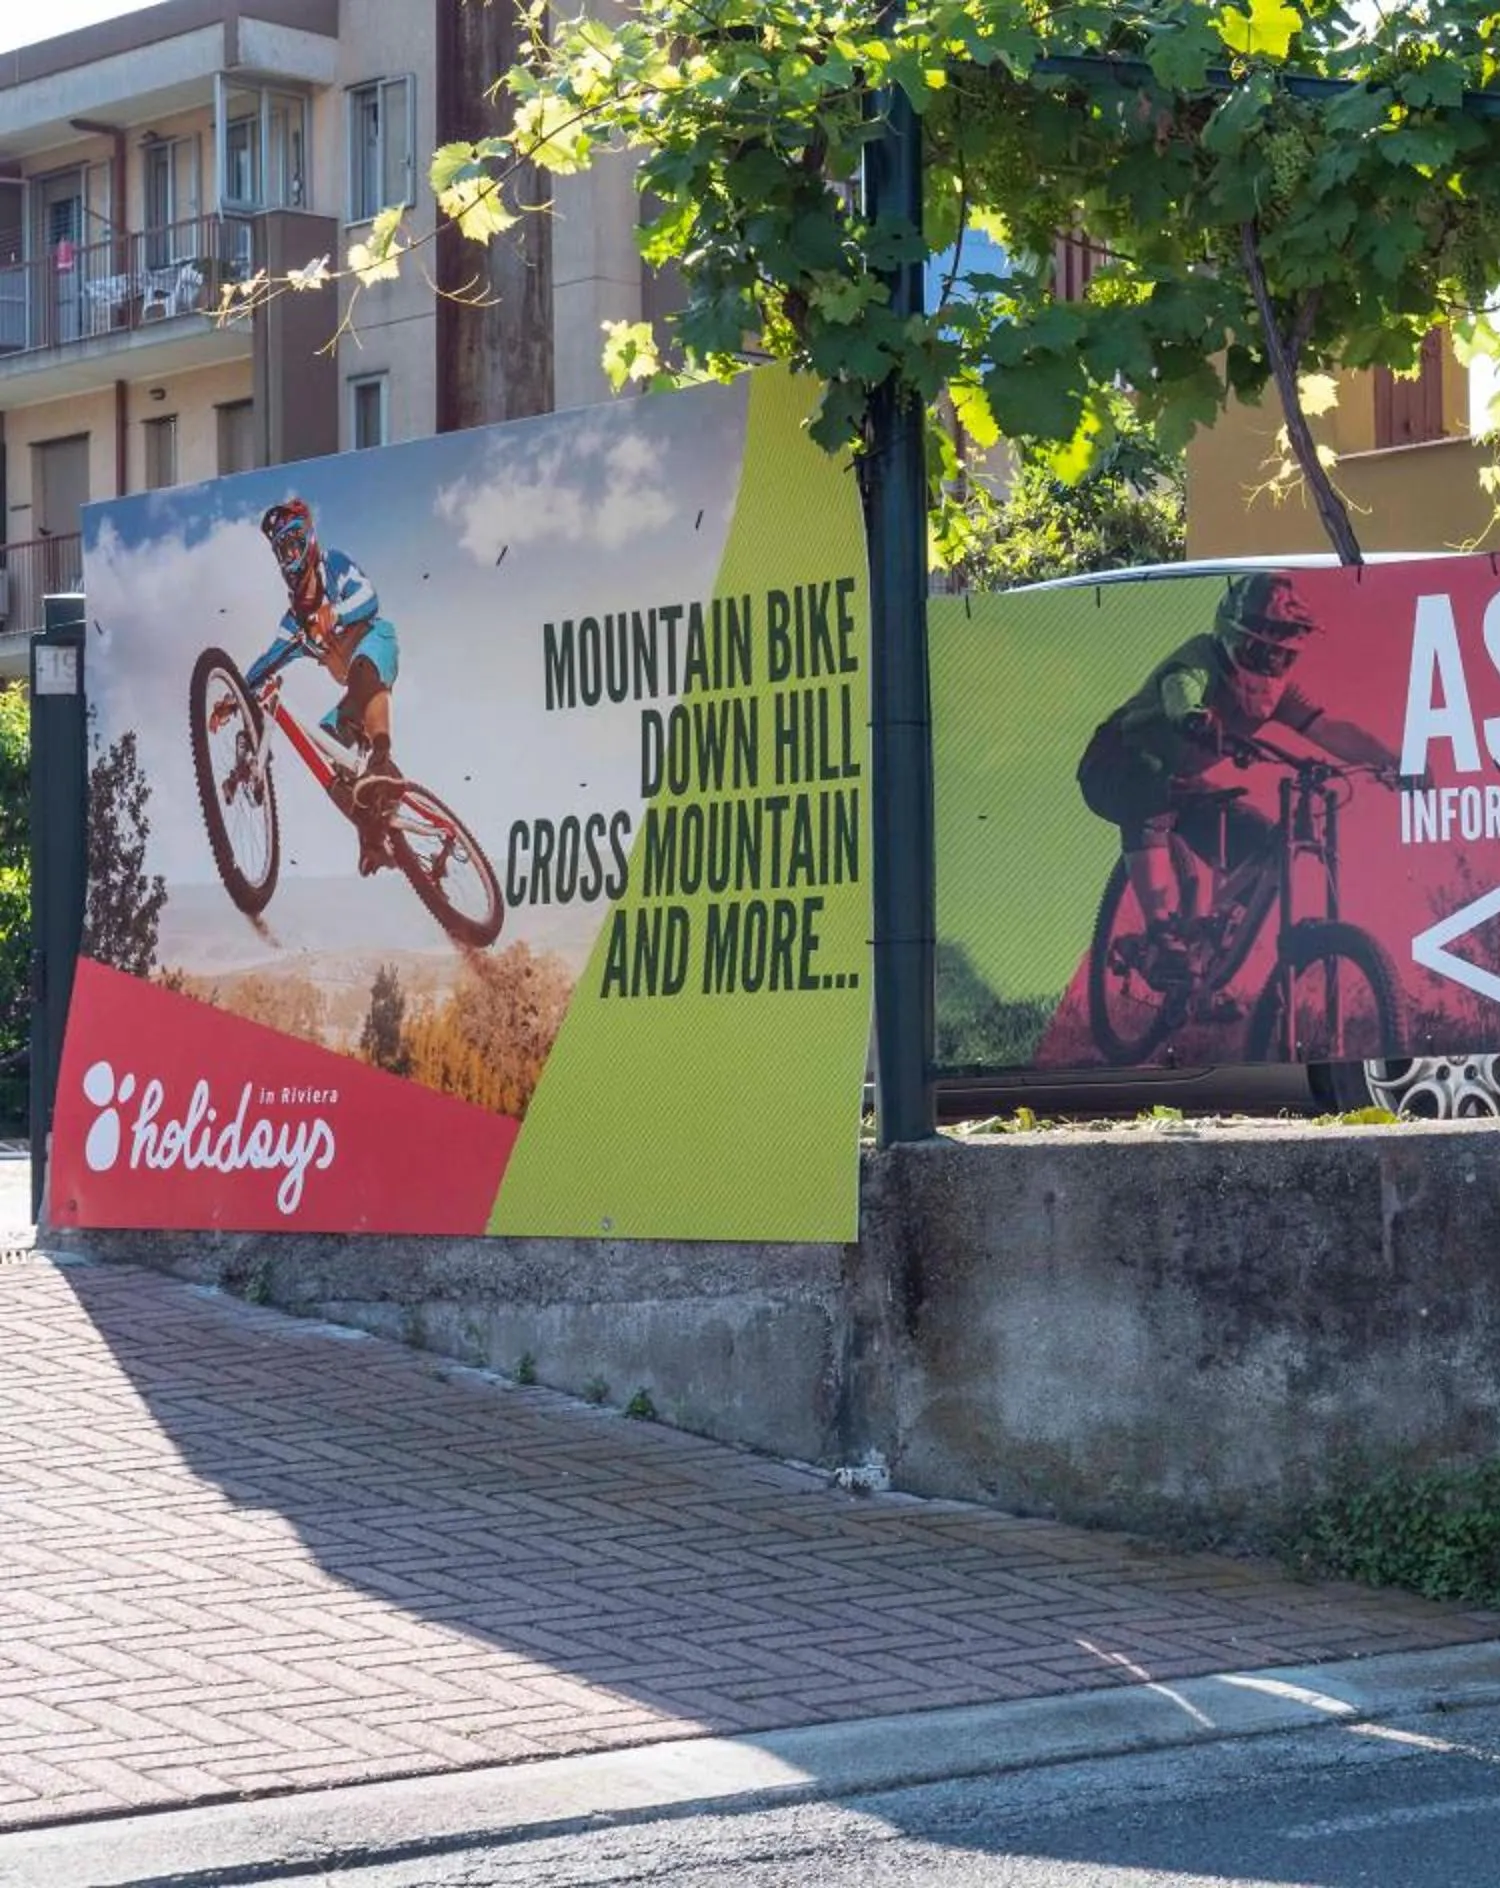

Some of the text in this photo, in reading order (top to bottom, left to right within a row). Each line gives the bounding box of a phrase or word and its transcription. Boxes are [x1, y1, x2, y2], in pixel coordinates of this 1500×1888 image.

[543, 577, 859, 711] MOUNTAIN BIKE
[640, 684, 860, 798] DOWN HILL
[506, 788, 859, 908] CROSS MOUNTAIN
[600, 897, 859, 998] AND MORE...
[130, 1079, 335, 1215] holidays
[260, 1087, 339, 1104] in Riviera
